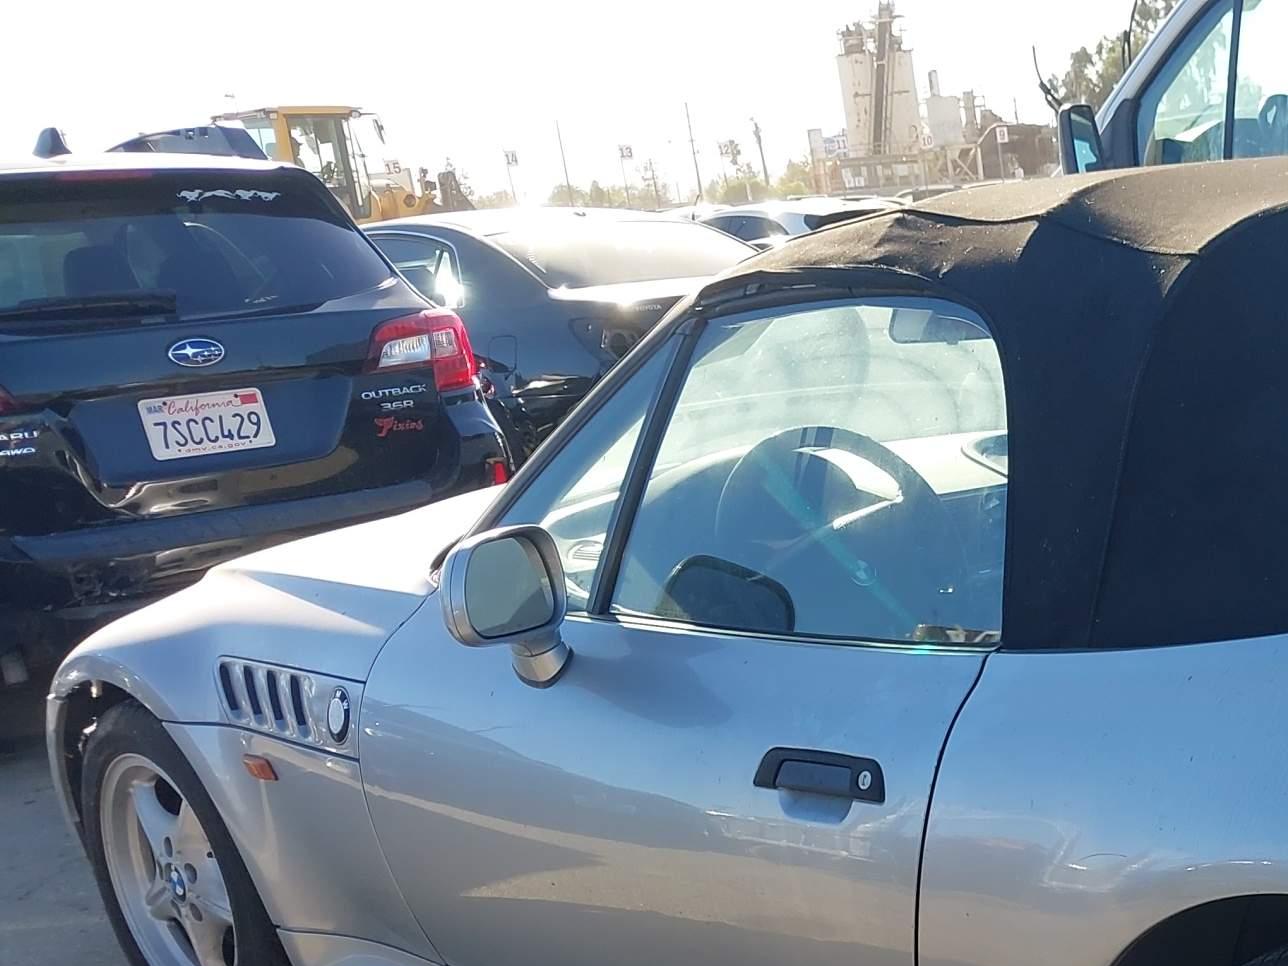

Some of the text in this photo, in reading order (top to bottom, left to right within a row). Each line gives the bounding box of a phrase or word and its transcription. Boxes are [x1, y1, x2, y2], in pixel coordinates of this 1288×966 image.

[921, 136, 933, 146] 10
[505, 152, 518, 165] 14
[620, 146, 632, 158] 13
[385, 162, 401, 175] 15
[361, 384, 427, 400] OUTBACK
[167, 400, 242, 416] California
[153, 411, 261, 450] 7SCC429
[185, 442, 246, 453] dmv.ca.gov
